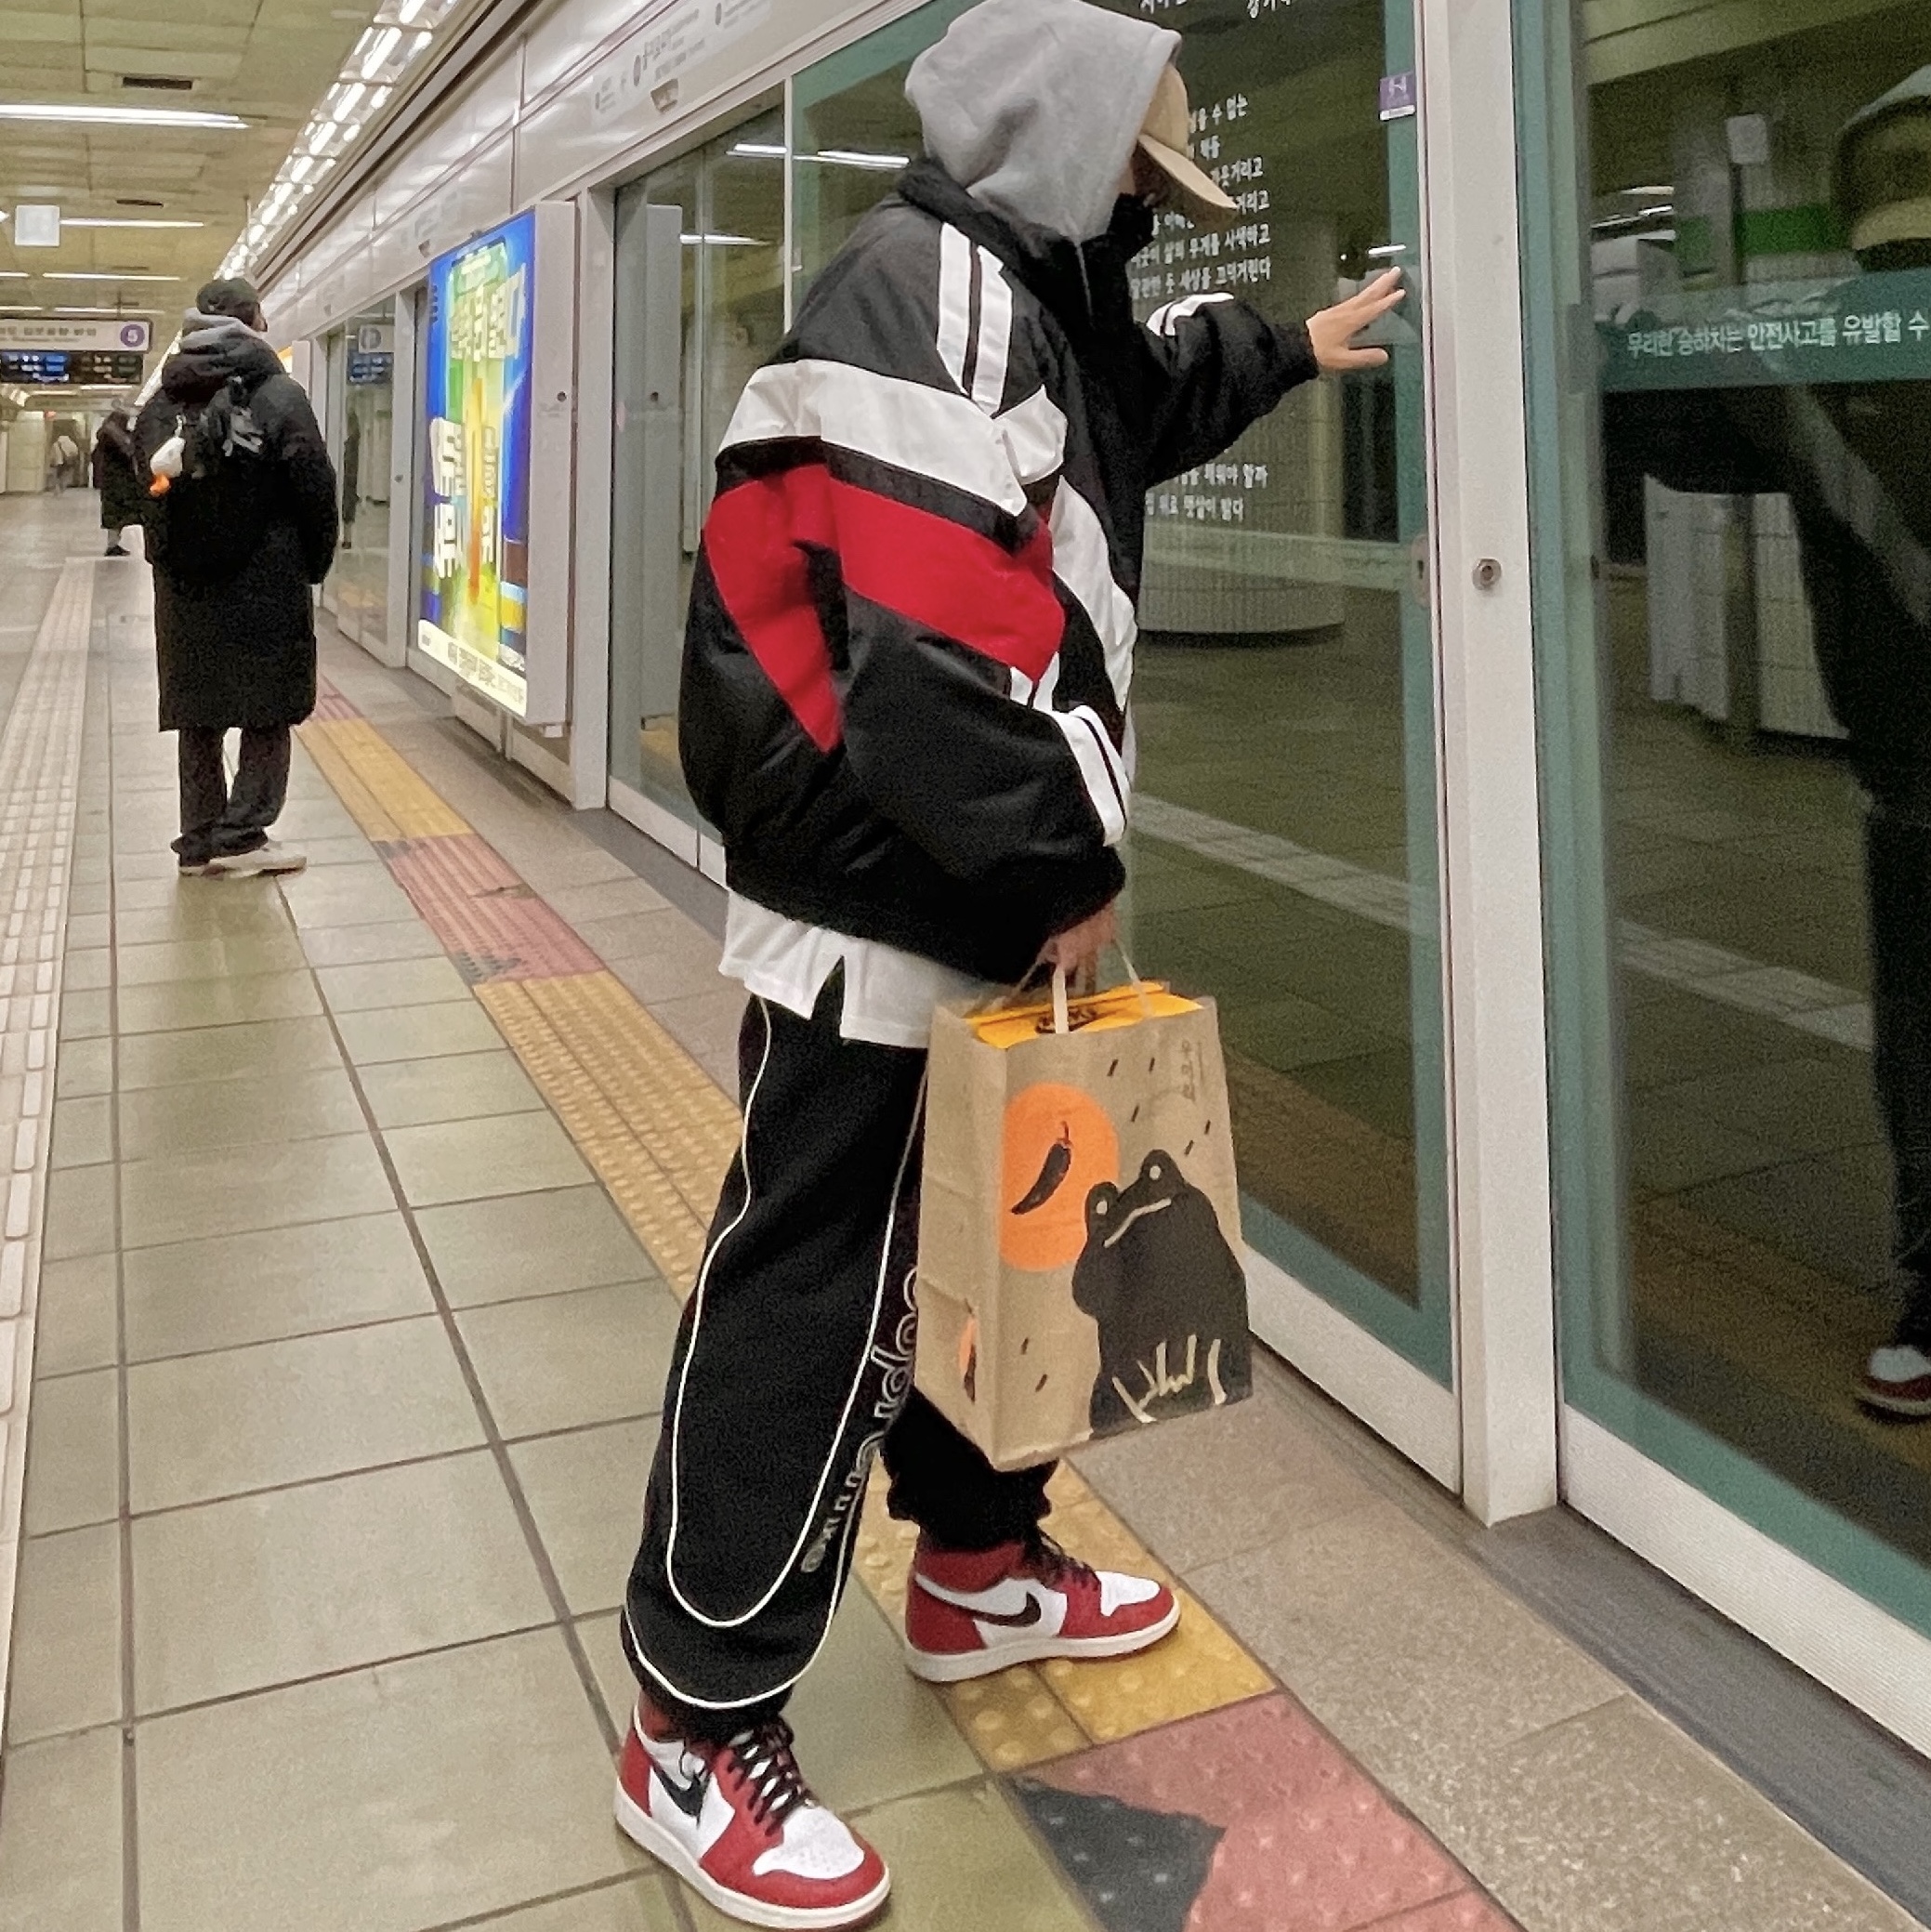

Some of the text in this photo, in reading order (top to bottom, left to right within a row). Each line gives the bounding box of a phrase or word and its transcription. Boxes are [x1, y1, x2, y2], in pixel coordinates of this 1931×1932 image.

[1628, 309, 1931, 359] 무리한 승하차는 안전사고를 유발할 수
